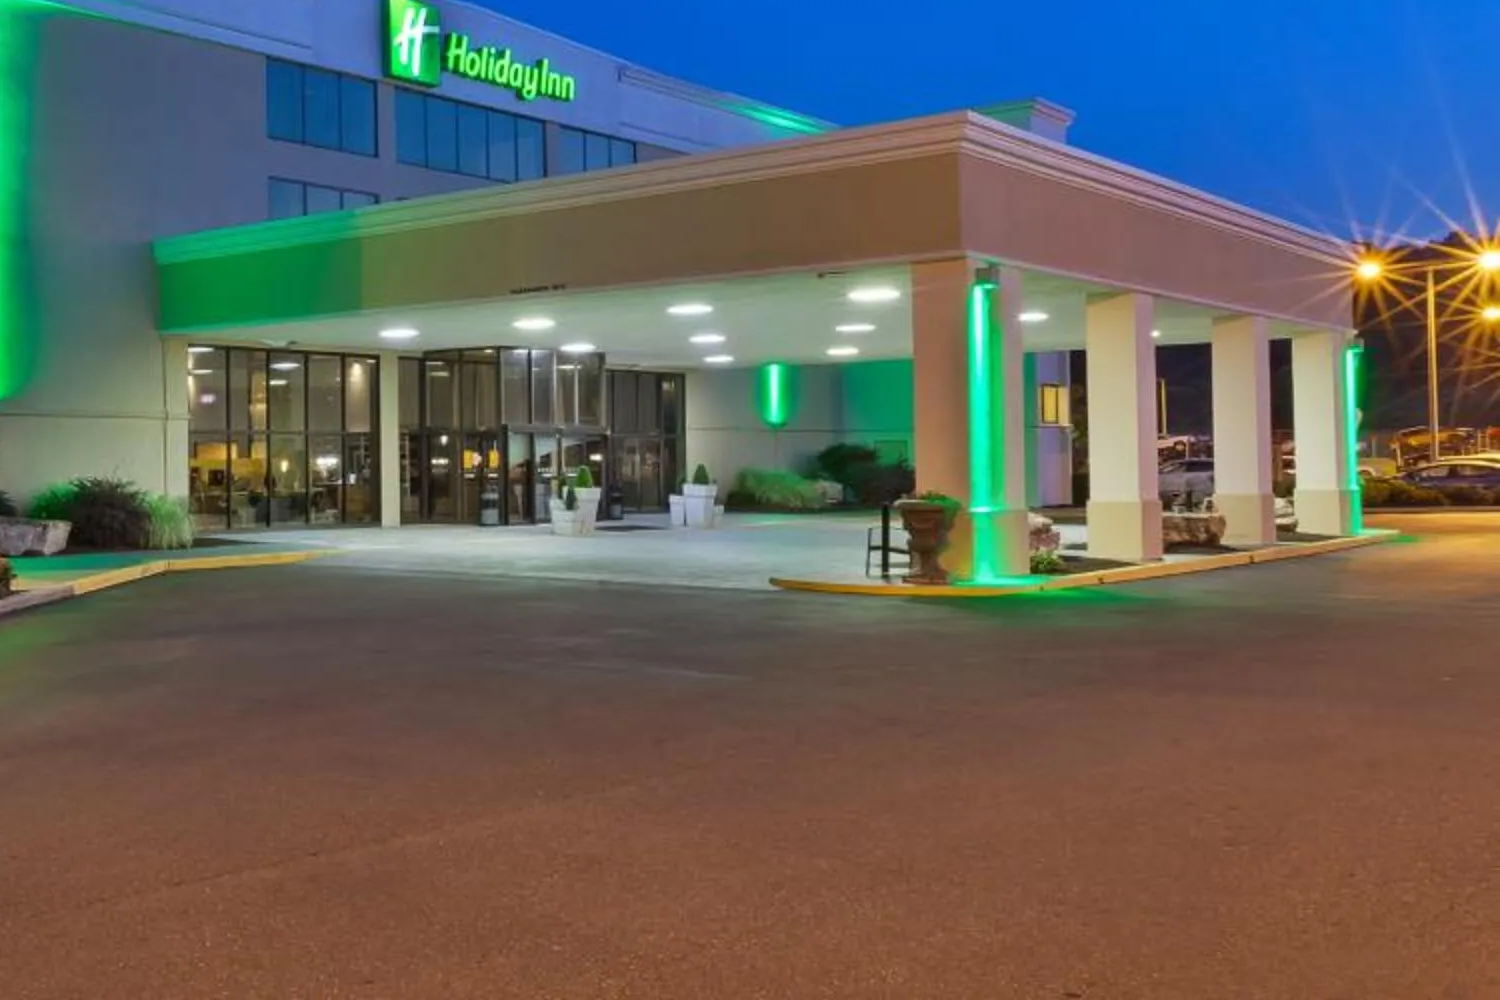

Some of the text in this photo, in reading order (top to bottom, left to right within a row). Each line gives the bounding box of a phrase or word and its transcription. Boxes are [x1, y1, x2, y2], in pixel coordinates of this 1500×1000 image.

[394, 6, 440, 77] H
[447, 31, 575, 101] Holiday Inn
